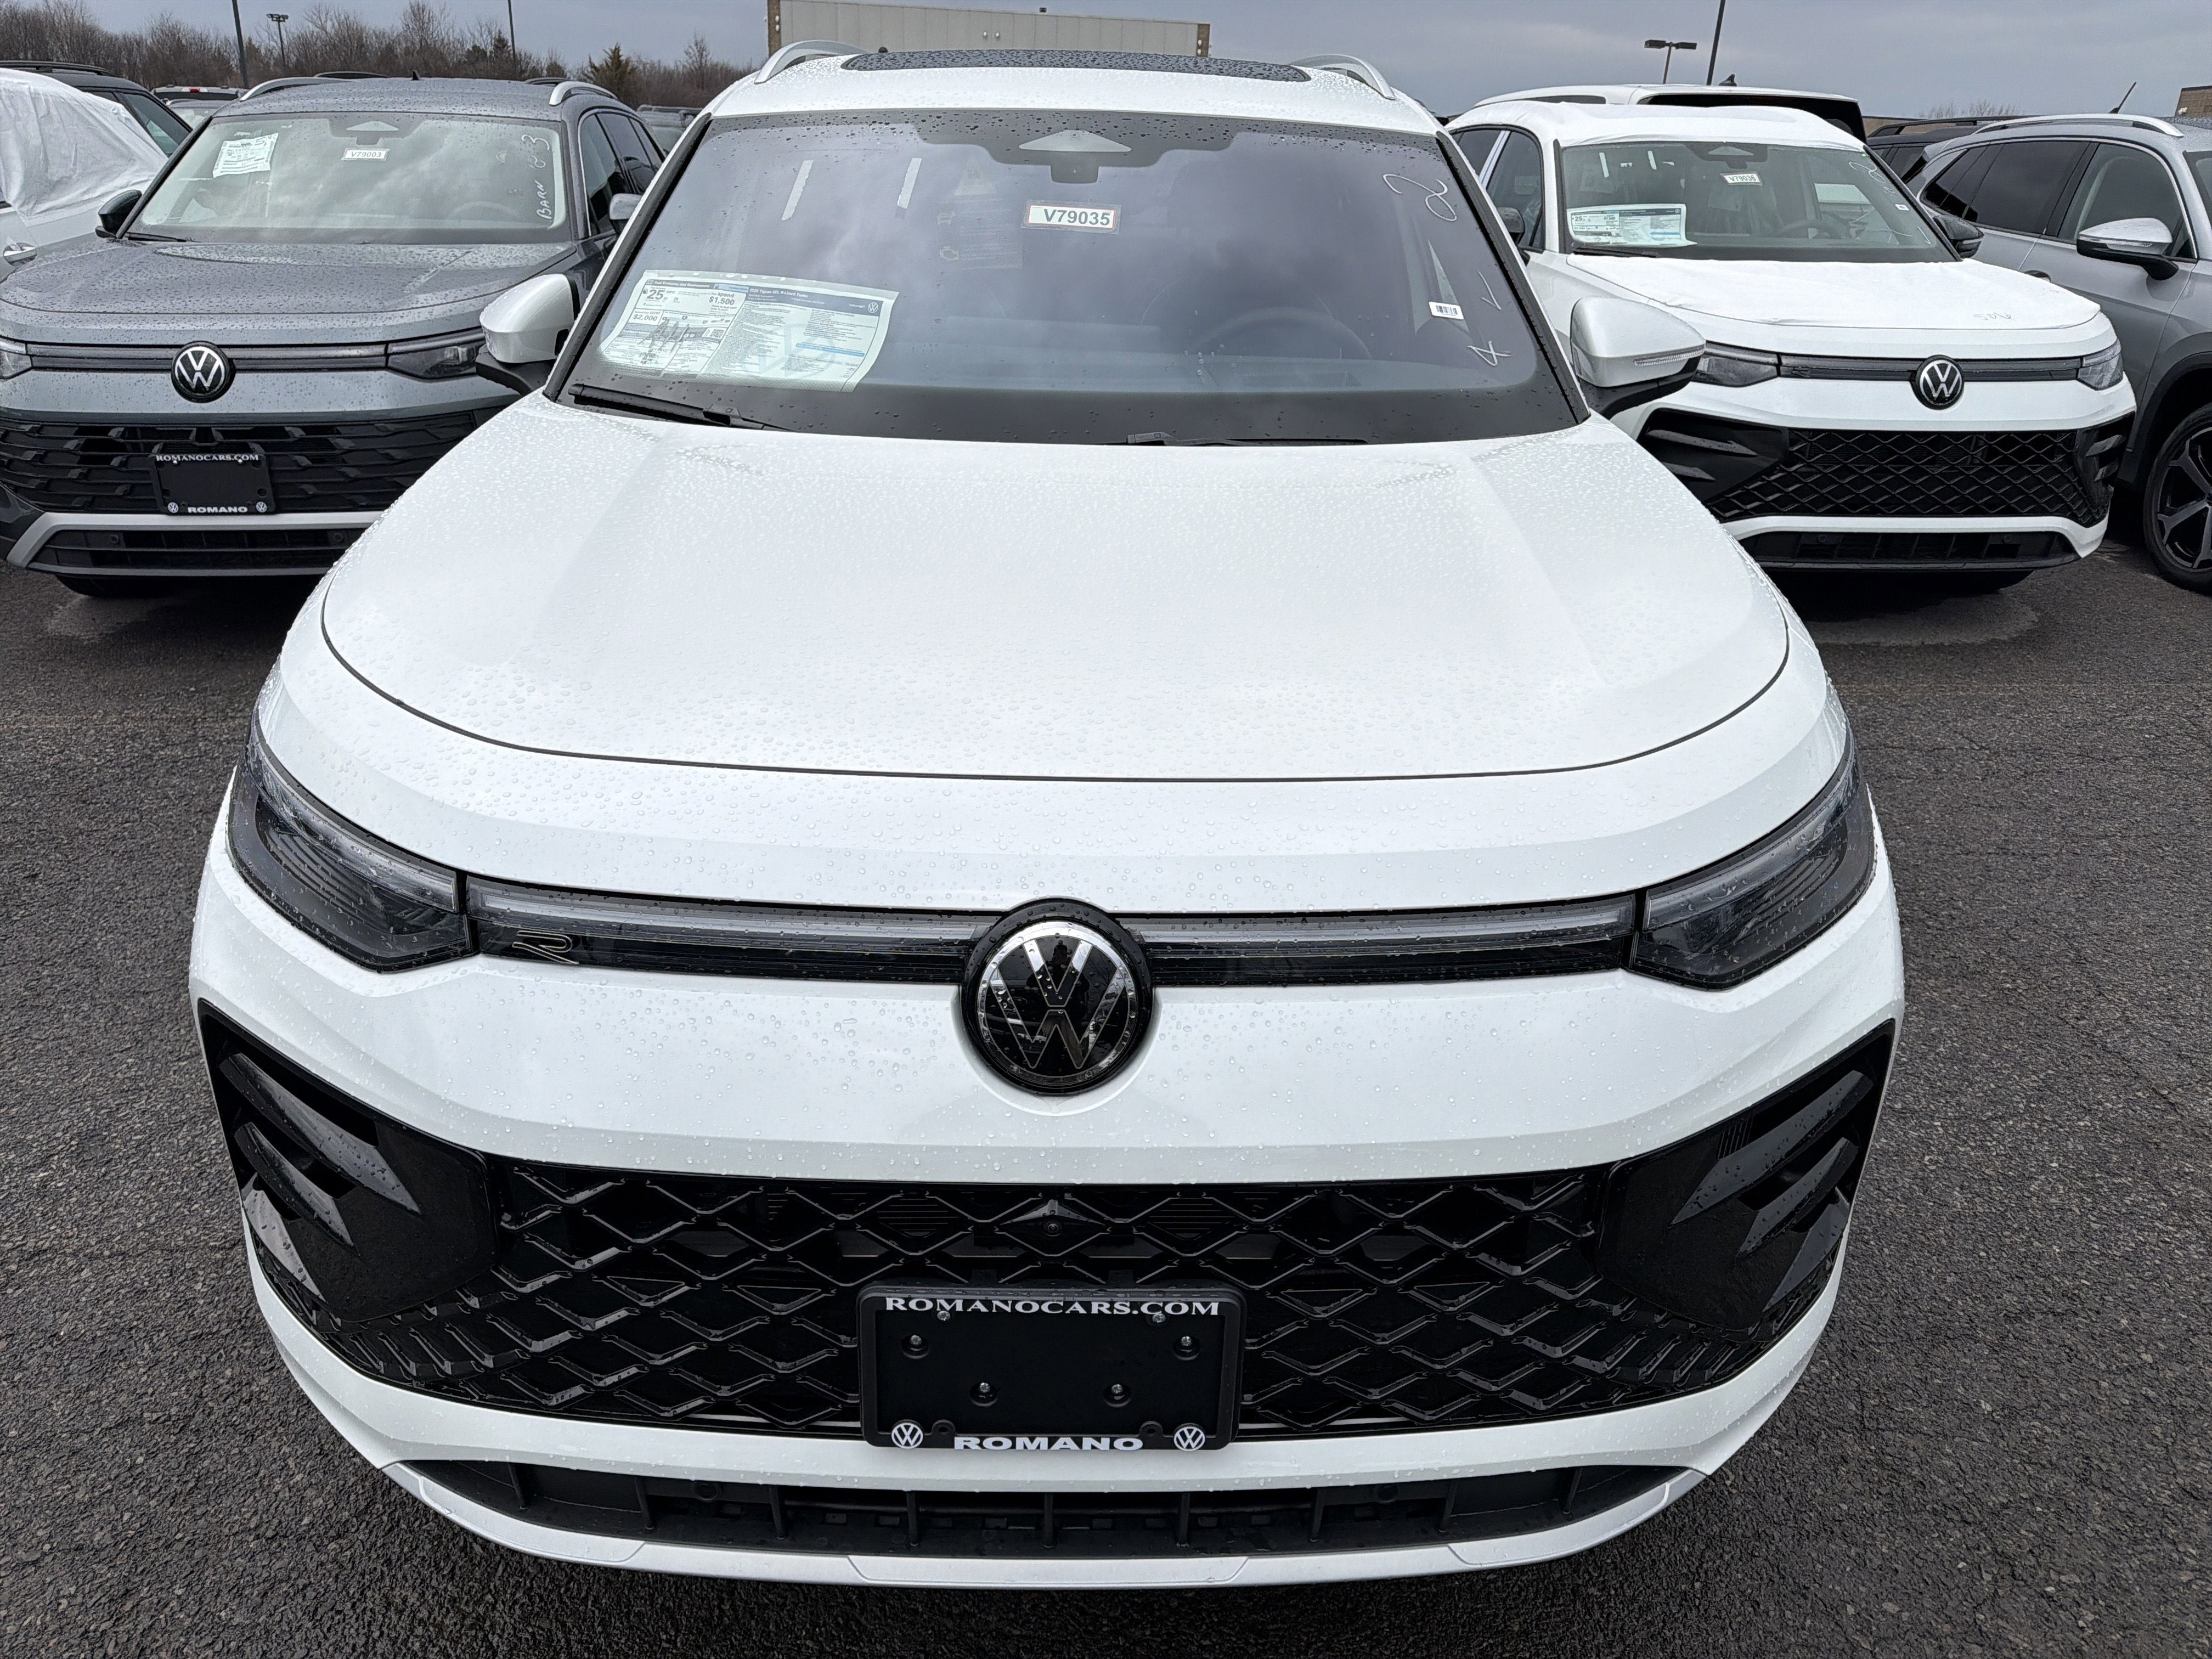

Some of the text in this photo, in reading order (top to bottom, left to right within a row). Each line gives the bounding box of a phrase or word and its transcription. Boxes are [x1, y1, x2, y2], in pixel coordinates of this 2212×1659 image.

[536, 179, 552, 219] BARN
[1043, 208, 1111, 226] V79035
[646, 289, 665, 300] 25
[709, 296, 735, 305] $1,500
[633, 313, 658, 321] $2,000
[885, 1297, 1219, 1316] ROMANOCARS.COM
[954, 1436, 1143, 1451] ROMANO
